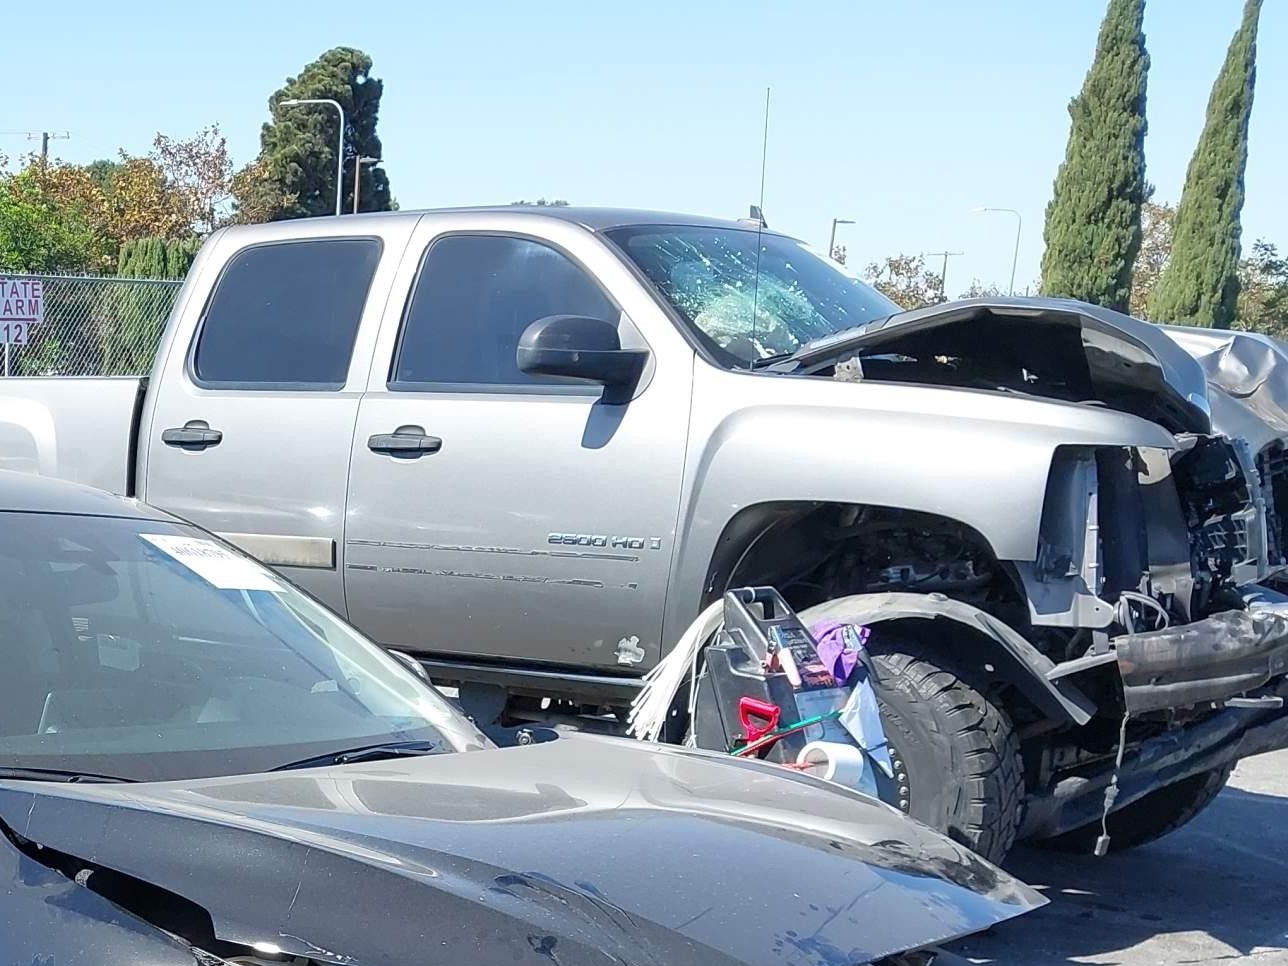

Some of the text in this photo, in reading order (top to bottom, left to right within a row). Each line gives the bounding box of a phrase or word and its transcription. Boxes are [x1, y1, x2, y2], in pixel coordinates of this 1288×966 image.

[3, 323, 23, 343] 12
[547, 532, 608, 548] 2500
[611, 535, 645, 550] HD
